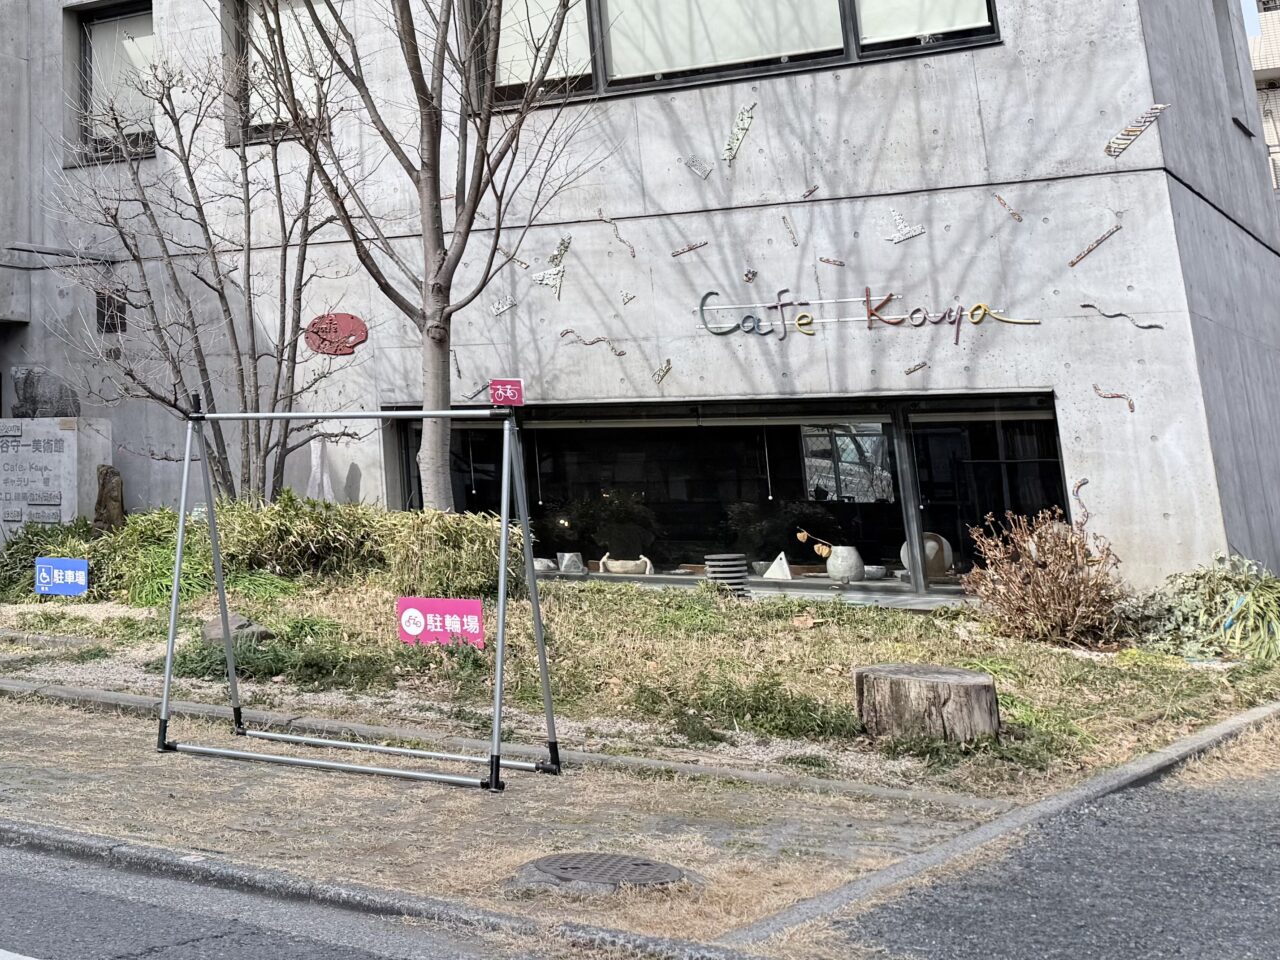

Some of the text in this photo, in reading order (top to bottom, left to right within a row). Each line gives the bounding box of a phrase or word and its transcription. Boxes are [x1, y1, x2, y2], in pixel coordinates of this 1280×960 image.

[864, 286, 1042, 346] Kaya
[53, 568, 86, 586] 駐車場
[426, 613, 480, 634] 駐輪場
